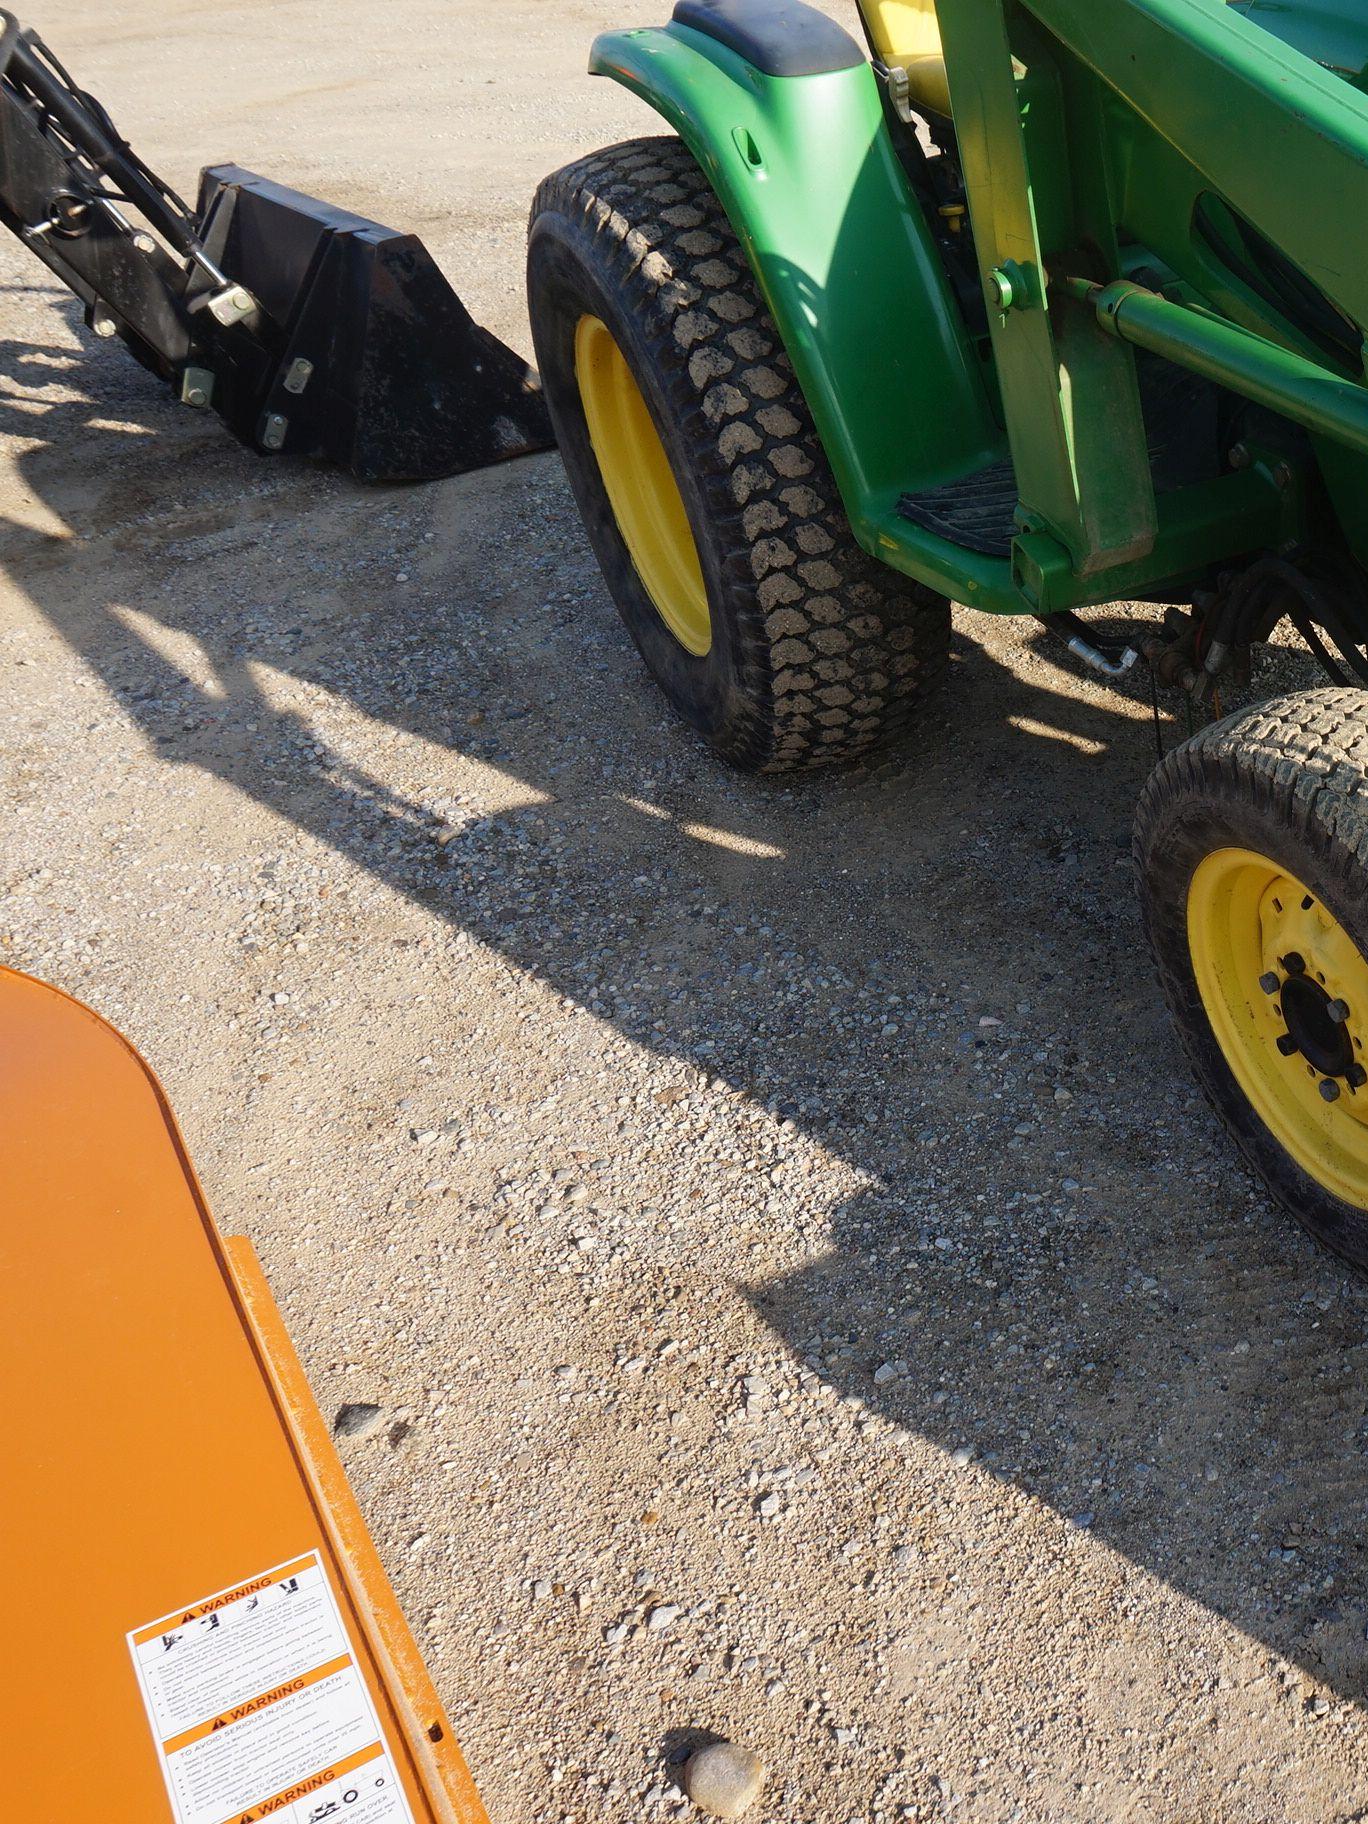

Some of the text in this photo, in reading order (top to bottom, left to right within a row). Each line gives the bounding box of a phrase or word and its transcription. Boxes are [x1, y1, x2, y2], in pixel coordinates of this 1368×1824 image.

[199, 1576, 272, 1615] WARNING
[230, 1677, 304, 1721] WARNING
[180, 1748, 193, 1758] TO
[194, 1733, 222, 1752] AVOID
[224, 1713, 263, 1737] SERIOUS
[265, 1697, 296, 1717] INJURY
[298, 1690, 311, 1700] OR
[257, 1768, 335, 1816] WARNING
